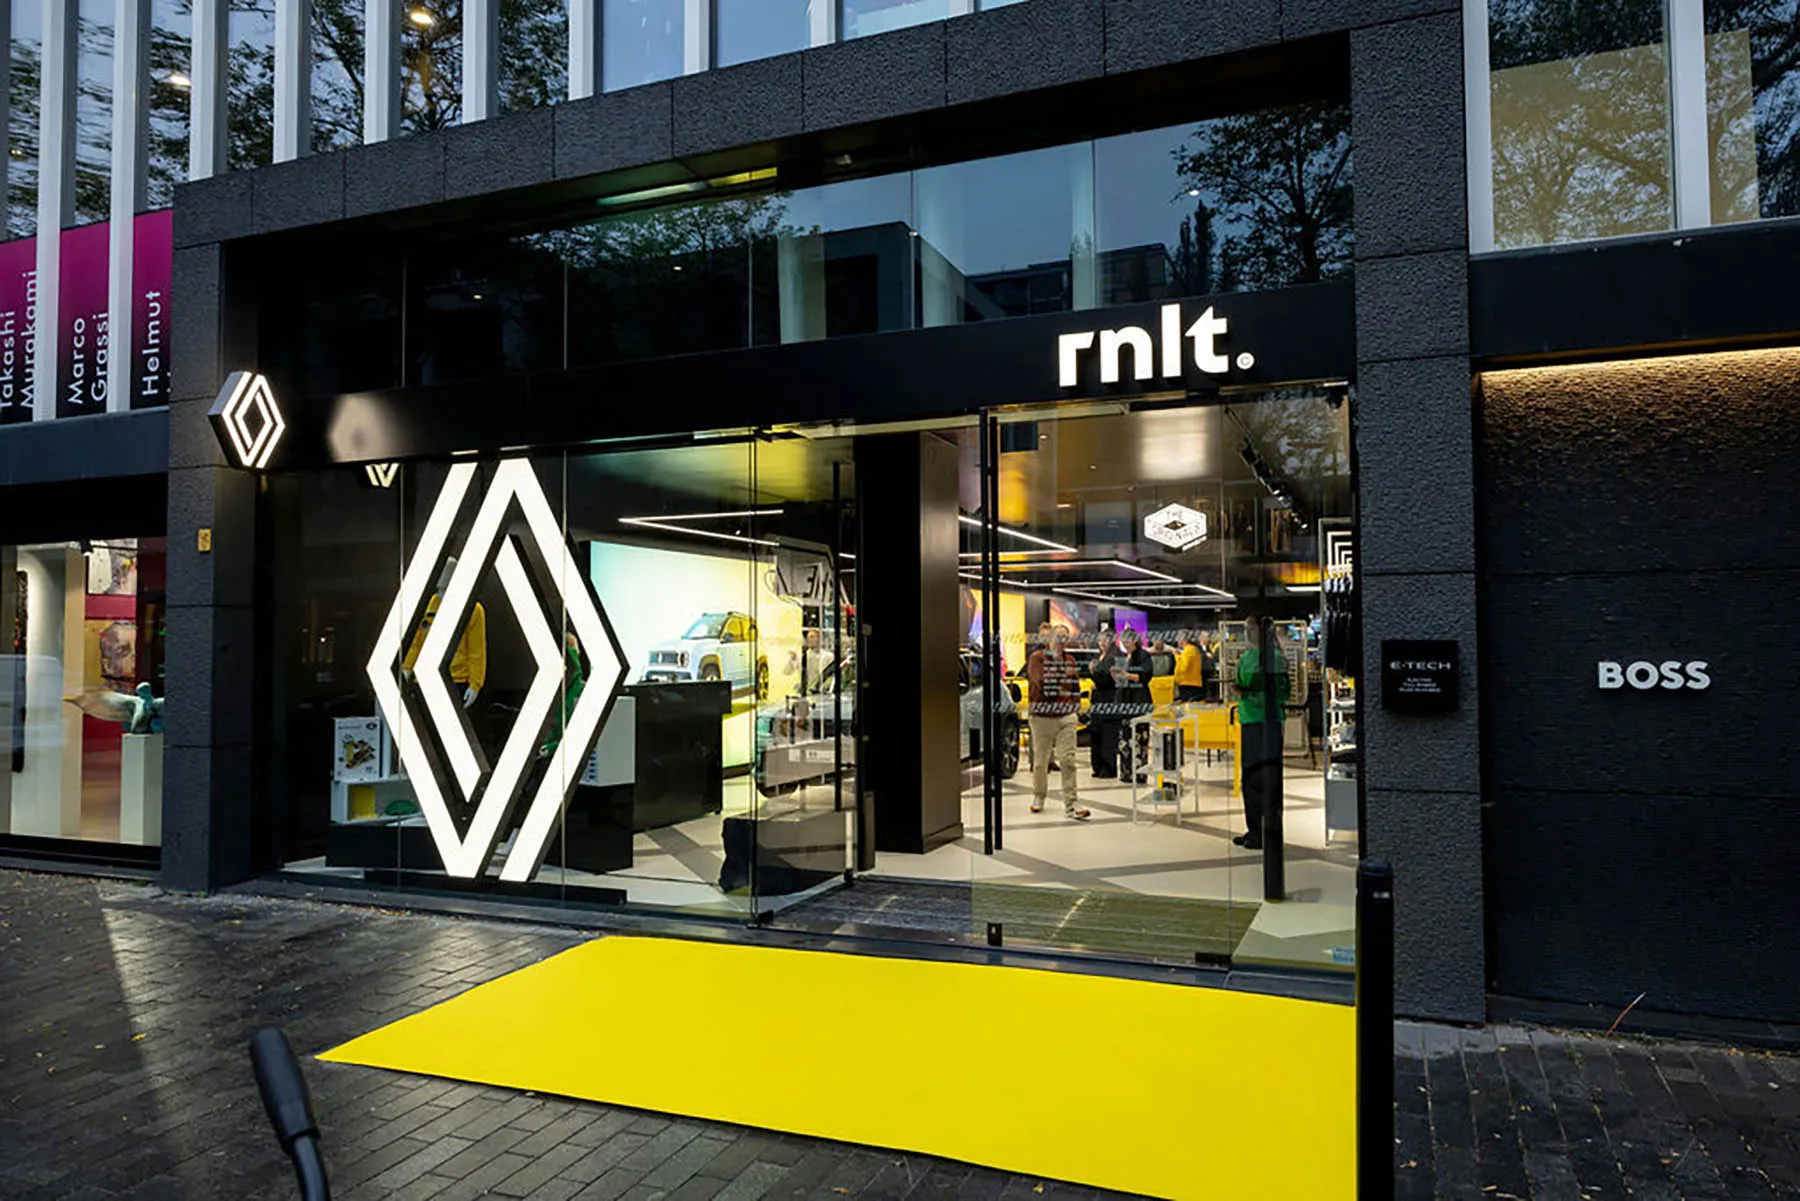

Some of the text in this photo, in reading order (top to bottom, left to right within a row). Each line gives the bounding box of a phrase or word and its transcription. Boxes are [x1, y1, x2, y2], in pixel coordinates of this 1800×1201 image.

[20, 270, 37, 408] Murakami
[67, 318, 86, 404] Marco
[91, 313, 108, 401] Grassi
[141, 291, 161, 395] Helmut
[1598, 660, 1711, 690] BOSS
